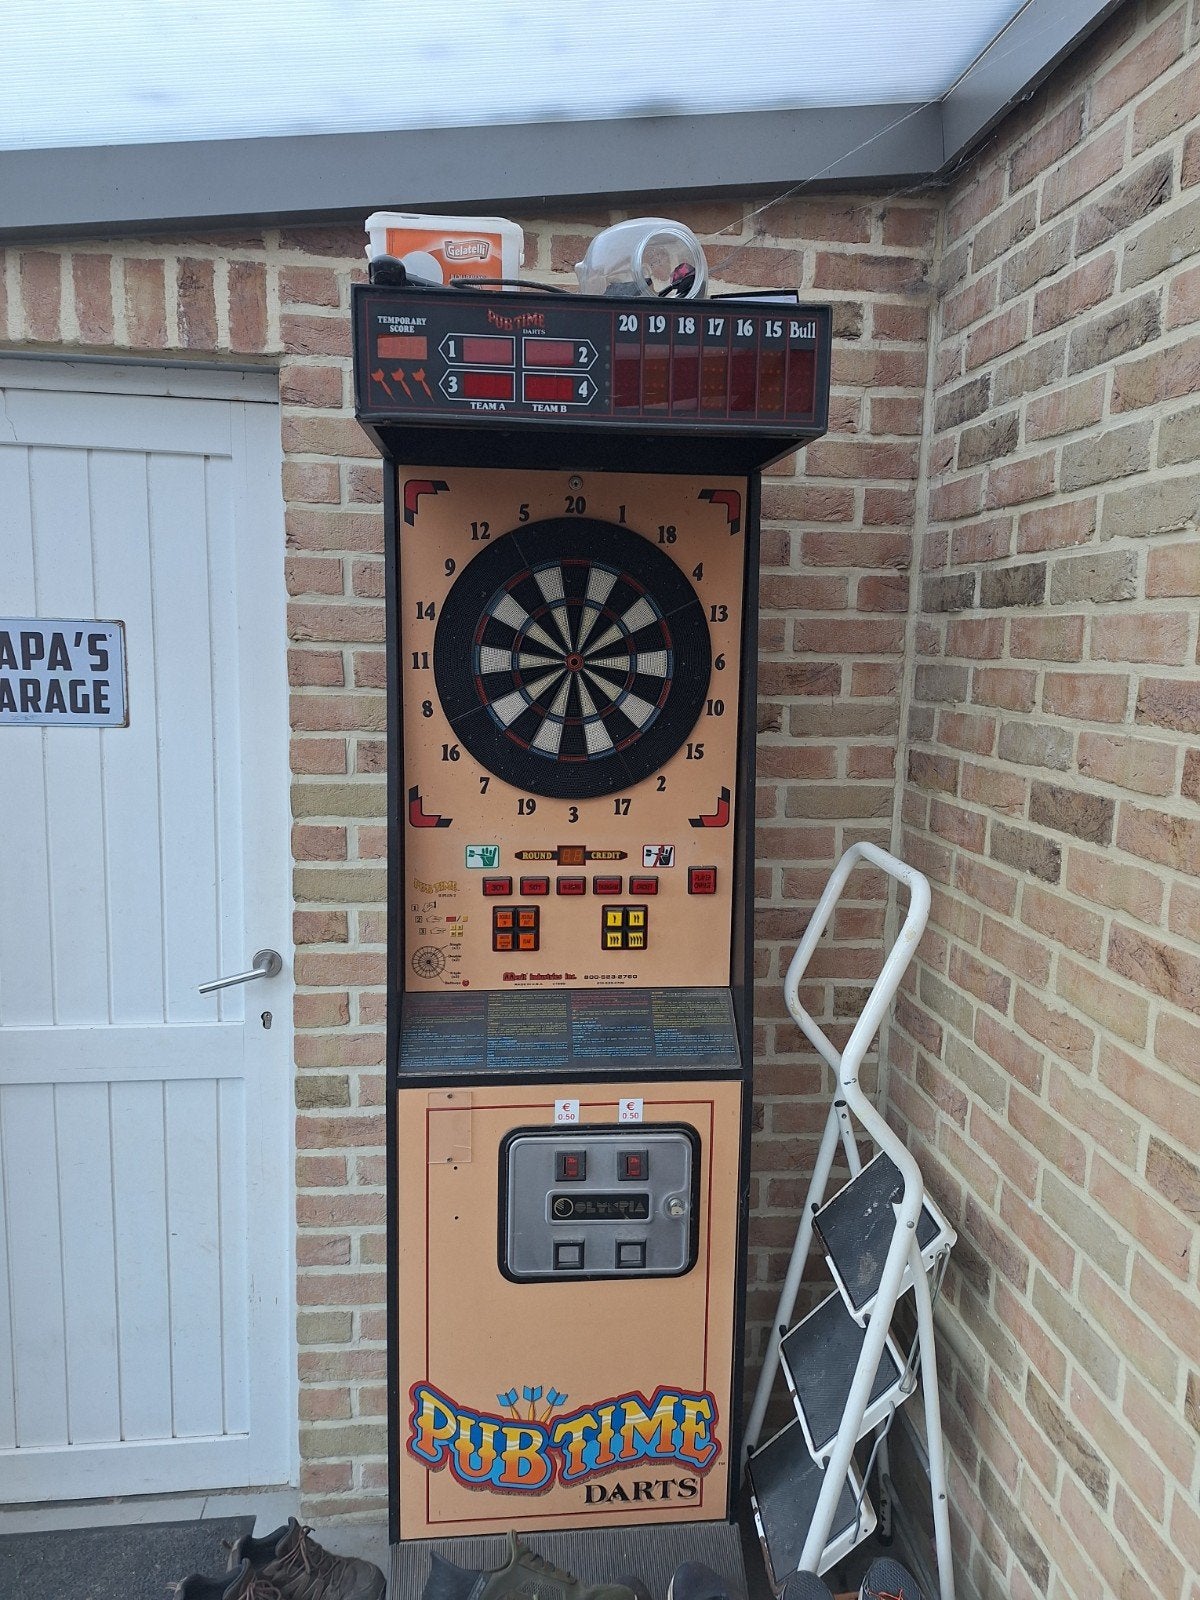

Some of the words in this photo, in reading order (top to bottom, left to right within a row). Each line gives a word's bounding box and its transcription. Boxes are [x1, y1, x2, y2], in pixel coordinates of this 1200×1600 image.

[448, 243, 487, 257] Gelatelli
[377, 315, 427, 326] TEMPORARY
[487, 308, 513, 331] PUB
[513, 312, 546, 329] TIME
[619, 314, 638, 332] 20
[648, 315, 666, 333] 19
[677, 316, 695, 335] 18
[708, 317, 725, 336] 17
[736, 318, 753, 337] 16
[765, 320, 783, 338] 15
[789, 321, 816, 339] Bull
[389, 324, 415, 334] SCORE
[448, 340, 456, 358] 1
[578, 347, 588, 363] 2
[448, 376, 459, 393] 3
[578, 380, 588, 398] 4
[470, 401, 496, 410] TEAM
[498, 402, 506, 411] A
[532, 403, 558, 413] TEAM
[559, 404, 567, 413] B
[518, 503, 530, 522] 5
[565, 495, 586, 515] 20
[619, 505, 626, 524] 1
[470, 521, 491, 540] 12
[658, 525, 677, 544] 18
[444, 557, 456, 577] 9
[692, 562, 704, 582] 4
[416, 601, 436, 621] 14
[710, 604, 728, 623] 13
[412, 651, 430, 670] 11
[714, 653, 726, 671] 6
[422, 700, 434, 718] 8
[706, 699, 725, 716] 10
[441, 744, 461, 762] 16
[685, 743, 705, 760] 15
[479, 776, 490, 795] 7
[656, 775, 667, 792] 2
[517, 798, 537, 816] 19
[568, 806, 579, 823] 3
[614, 798, 632, 816] 17
[522, 851, 552, 860] ROUND
[591, 851, 621, 860] CREDIT
[562, 1102, 571, 1112] €
[626, 1101, 636, 1111] €
[558, 1113, 576, 1121] 0.50
[622, 1111, 639, 1120] 0.50
[414, 1387, 551, 1488] PUB
[551, 1393, 718, 1477] TIME
[584, 1477, 698, 1505] DARTS
